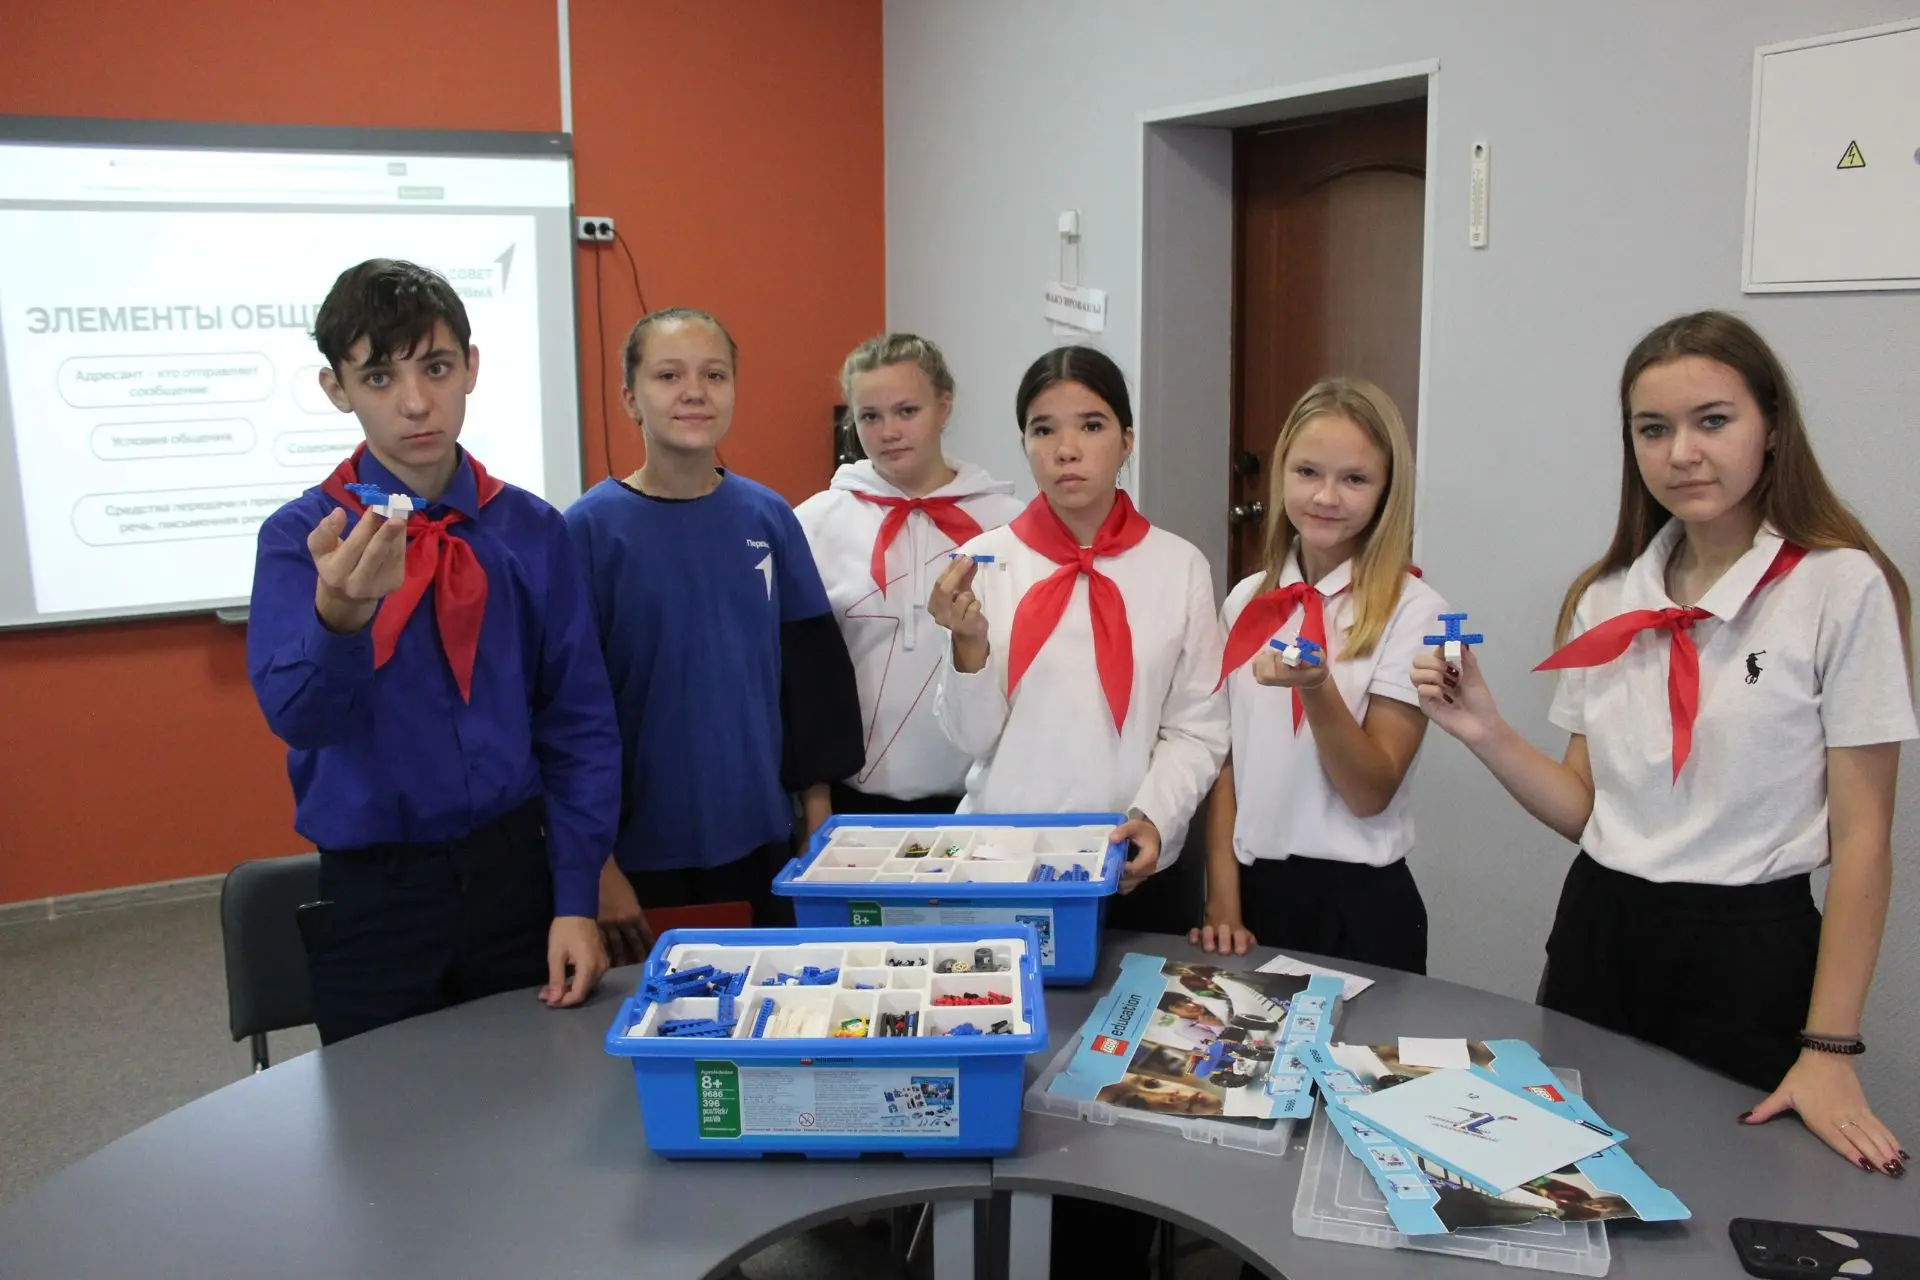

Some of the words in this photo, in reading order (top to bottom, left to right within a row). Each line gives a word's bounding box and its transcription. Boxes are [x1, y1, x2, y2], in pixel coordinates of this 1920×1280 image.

[26, 304, 222, 334] ЭЛЕМЕНТЫ
[75, 369, 144, 384] Адресант
[128, 384, 209, 397] сообщение
[111, 435, 167, 447] Условия
[105, 503, 170, 517] Средства
[853, 914, 870, 926] 8+
[1110, 994, 1142, 1036] education
[1101, 1037, 1120, 1055] LEGO
[701, 1075, 723, 1089] 8+
[702, 1090, 724, 1098] 9686
